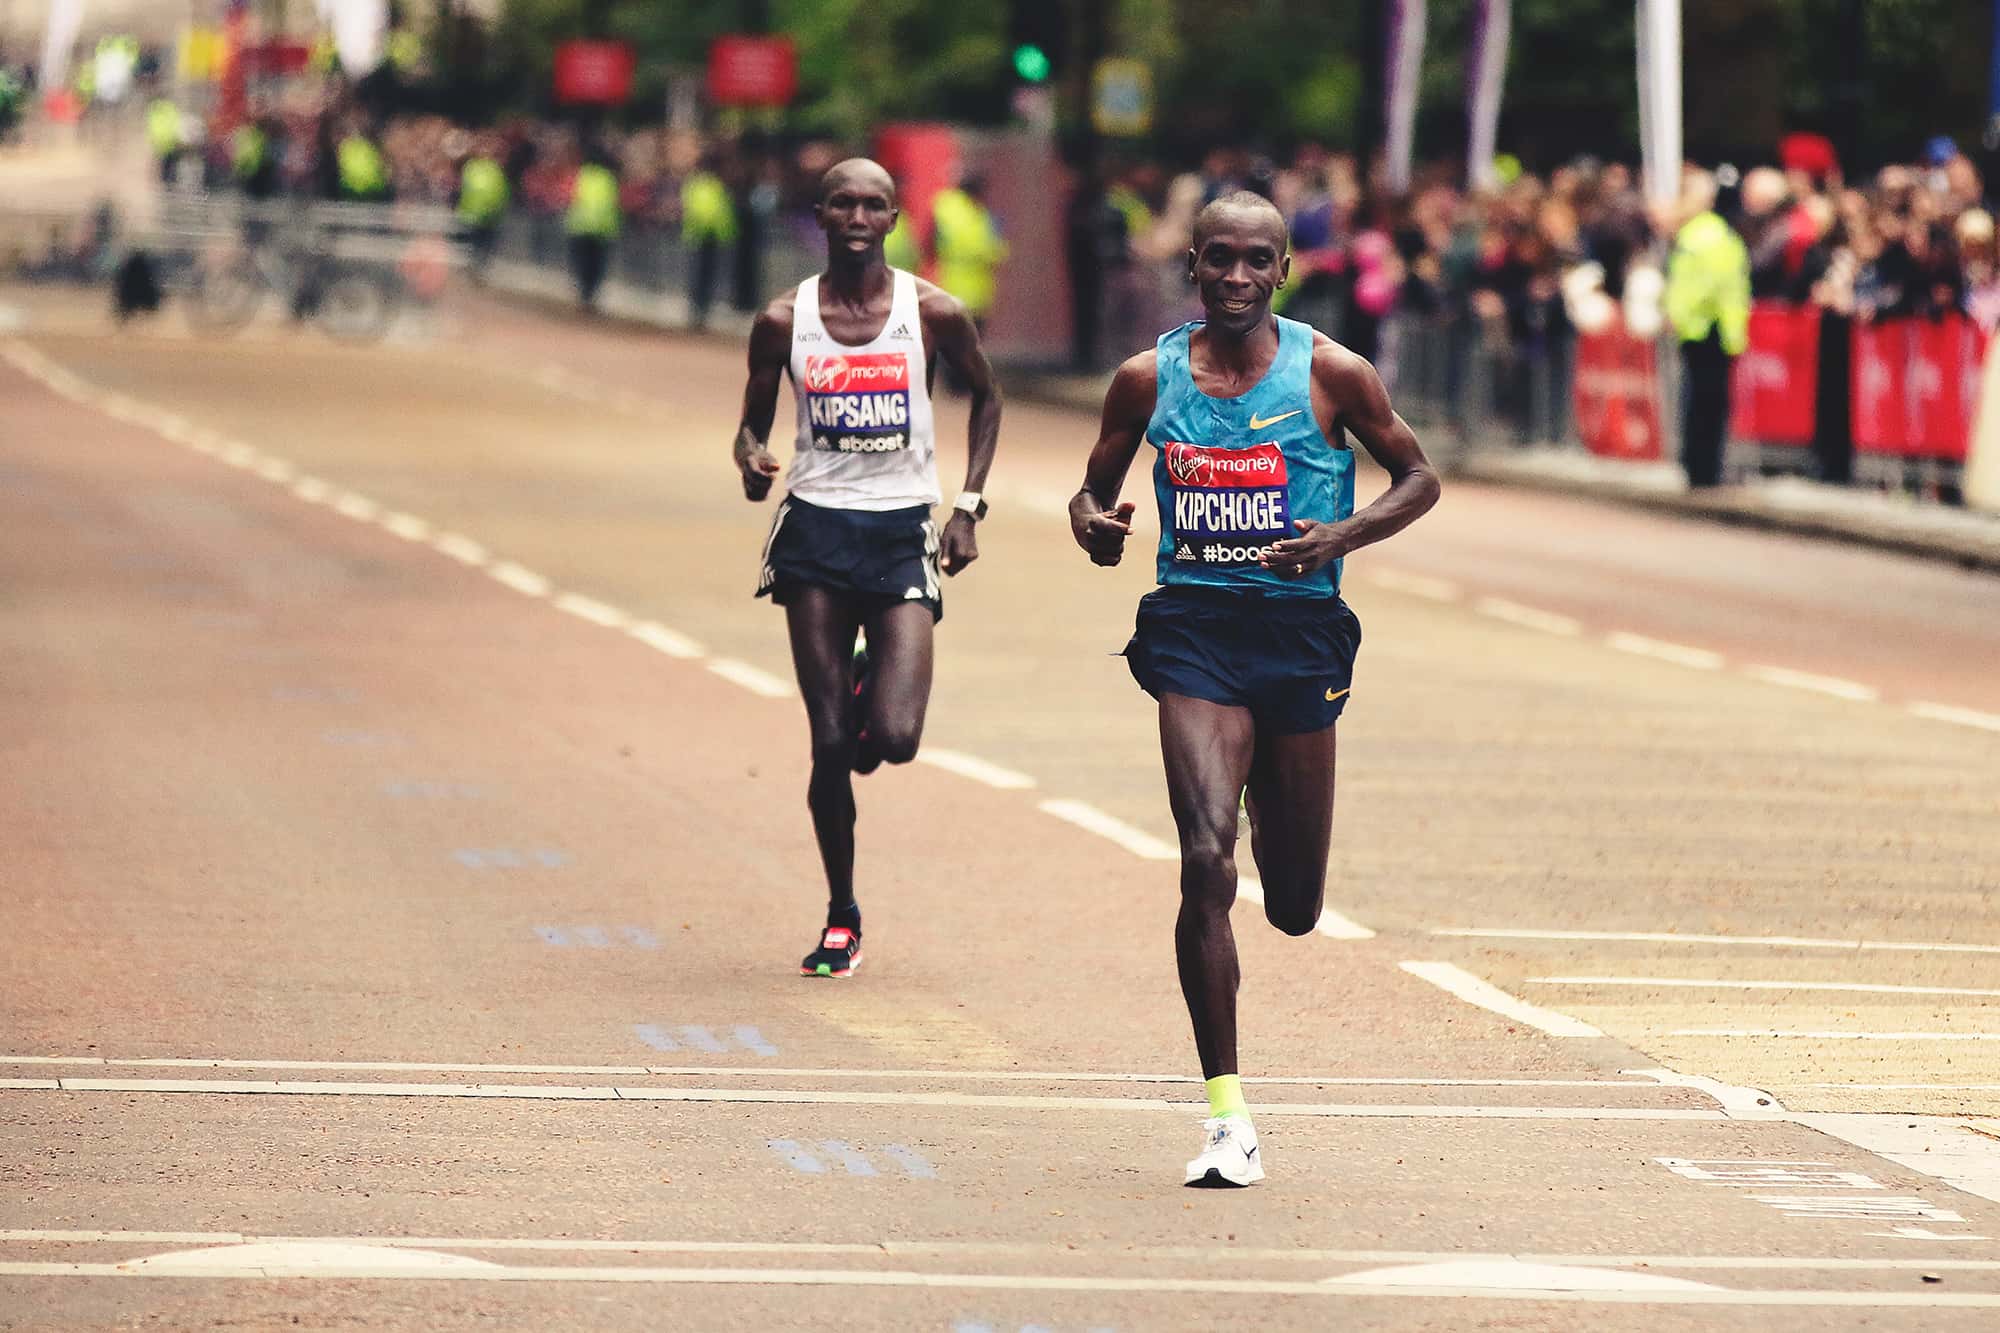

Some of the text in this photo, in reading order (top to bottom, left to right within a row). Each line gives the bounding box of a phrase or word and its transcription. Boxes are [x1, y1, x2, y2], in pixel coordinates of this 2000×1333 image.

[851, 365, 904, 381] money
[809, 393, 906, 427] KIPSANG
[838, 432, 904, 452] #boost
[1173, 444, 1279, 483] Virgin money
[1175, 491, 1284, 532] KIPCHOGE
[1203, 543, 1273, 562] #boos
